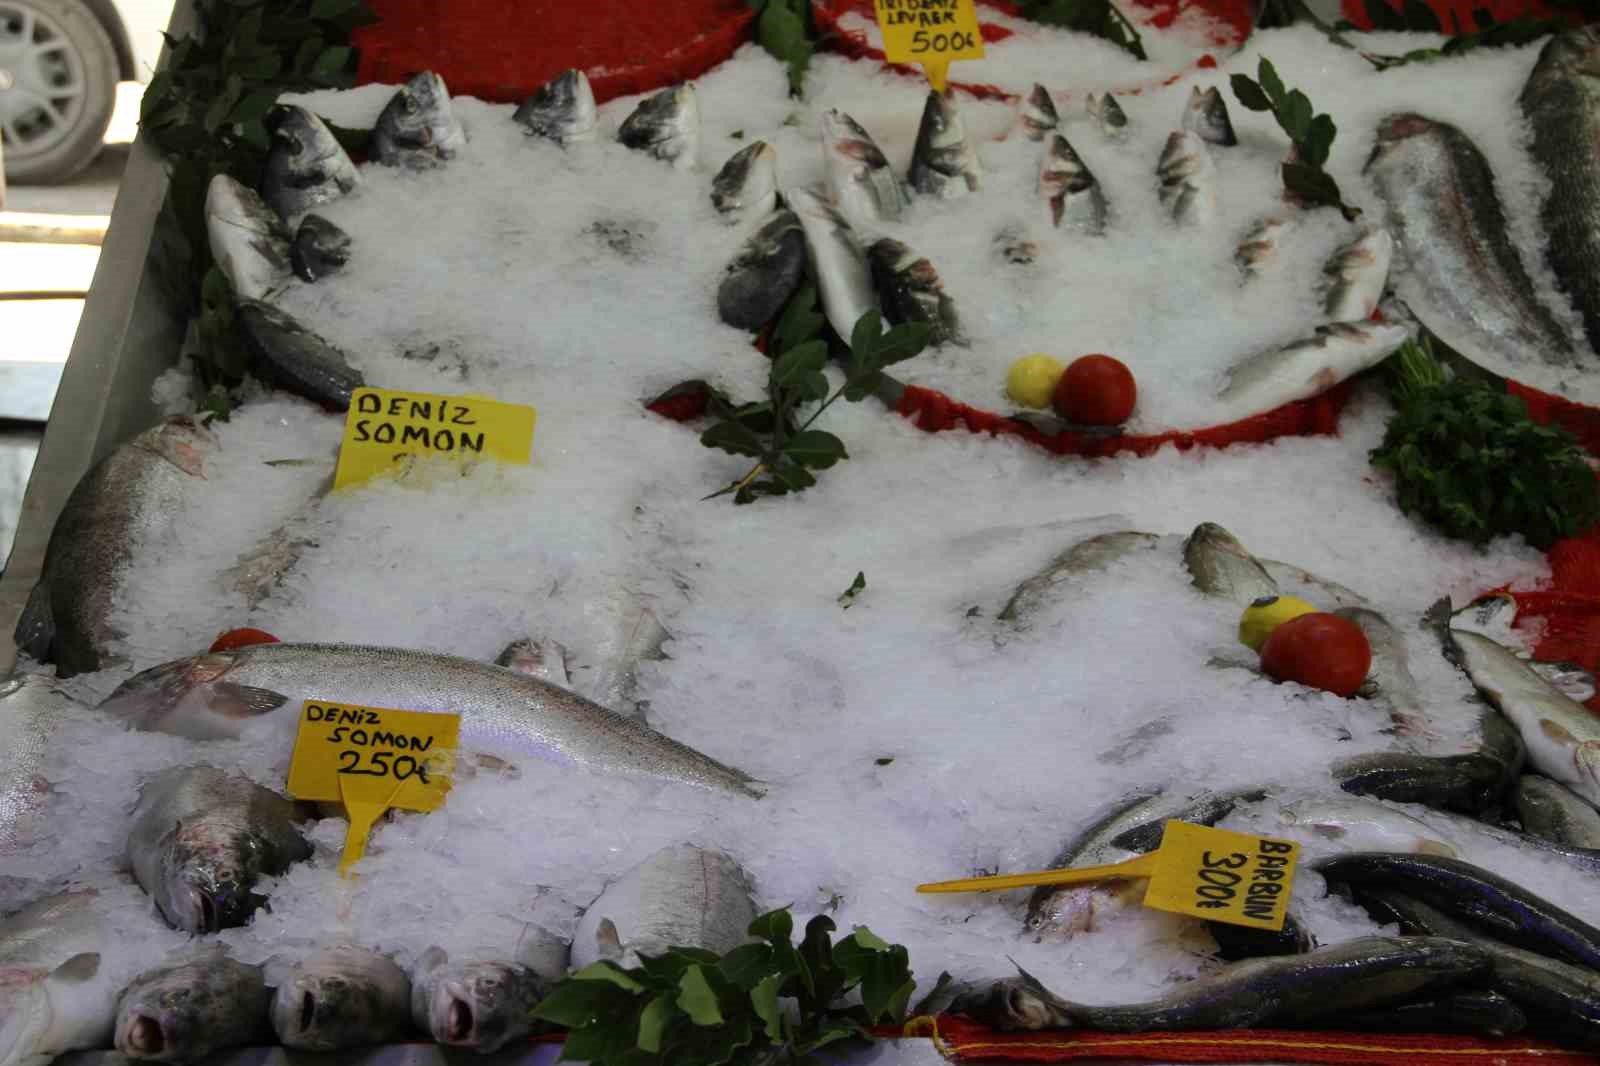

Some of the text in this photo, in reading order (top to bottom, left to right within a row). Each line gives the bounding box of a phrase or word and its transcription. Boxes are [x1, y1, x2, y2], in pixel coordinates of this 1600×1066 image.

[886, 10, 956, 27] LEVREK
[353, 420, 485, 453] SOMON
[327, 727, 434, 752] SOMON
[1242, 839, 1293, 921] BARBUN
